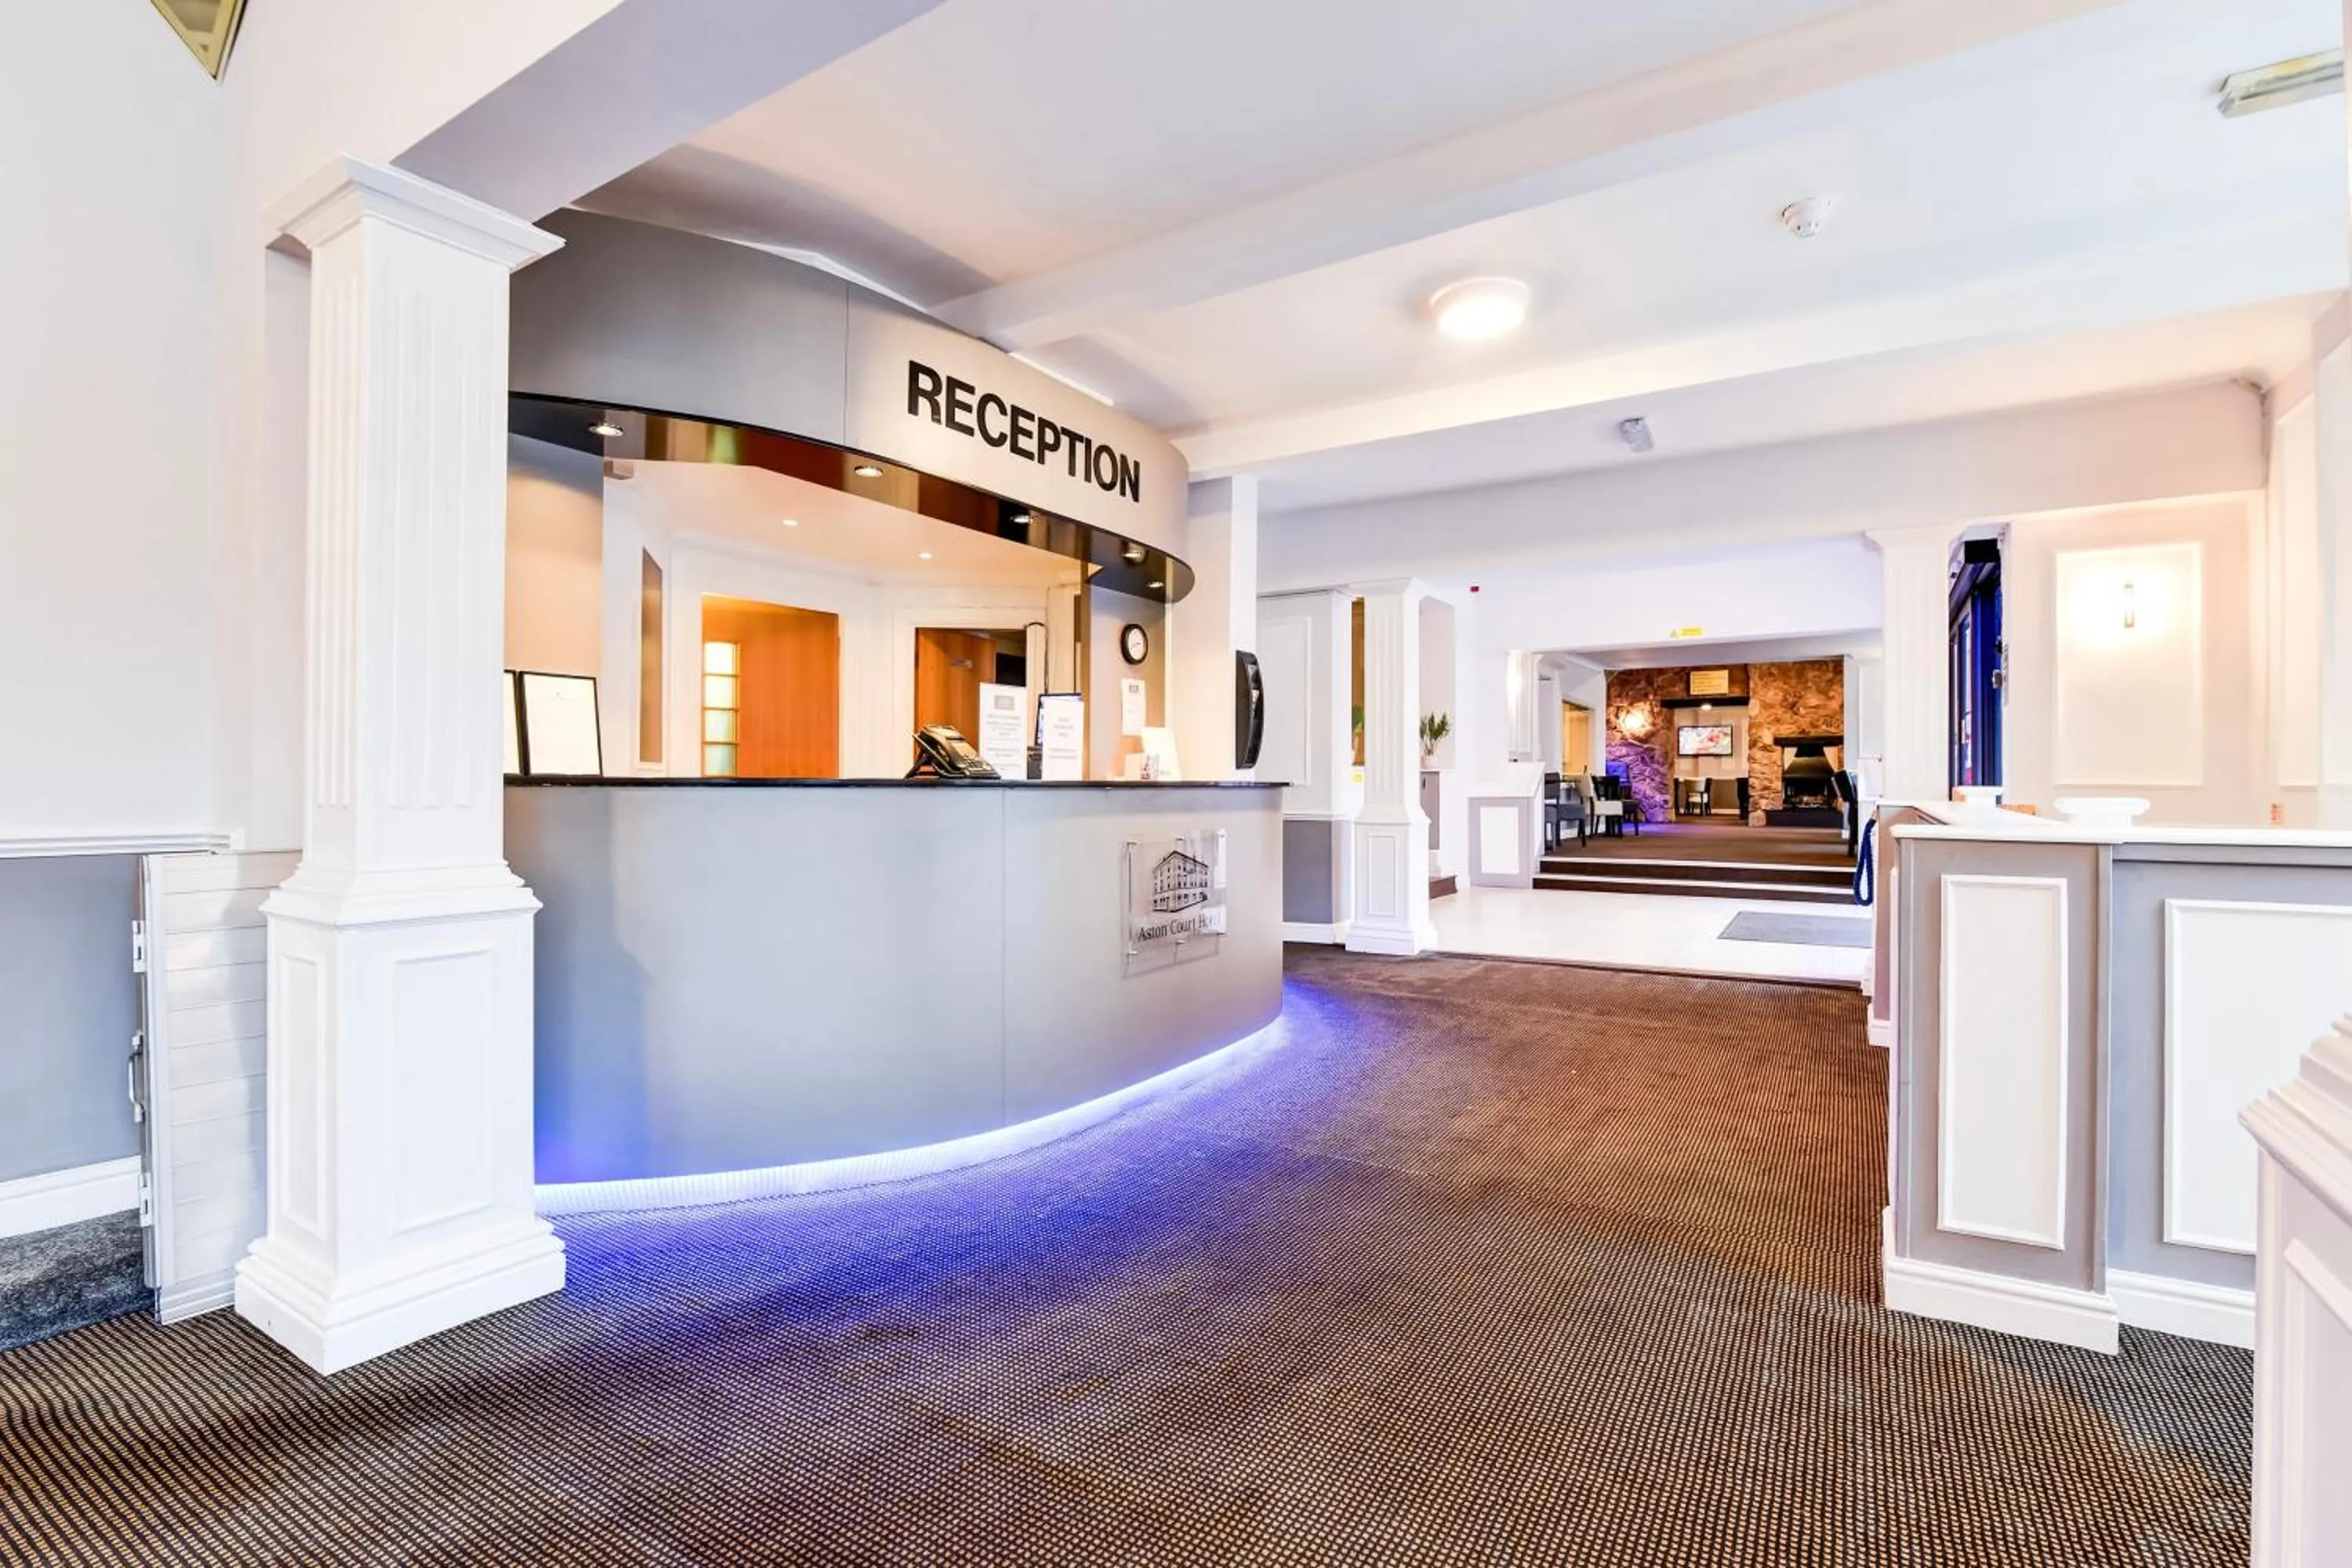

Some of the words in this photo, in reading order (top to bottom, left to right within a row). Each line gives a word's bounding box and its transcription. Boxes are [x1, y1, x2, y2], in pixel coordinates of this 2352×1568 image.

[908, 360, 1140, 503] RECEPTION
[1138, 924, 1167, 942] Aston
[1170, 918, 1196, 935] Court
